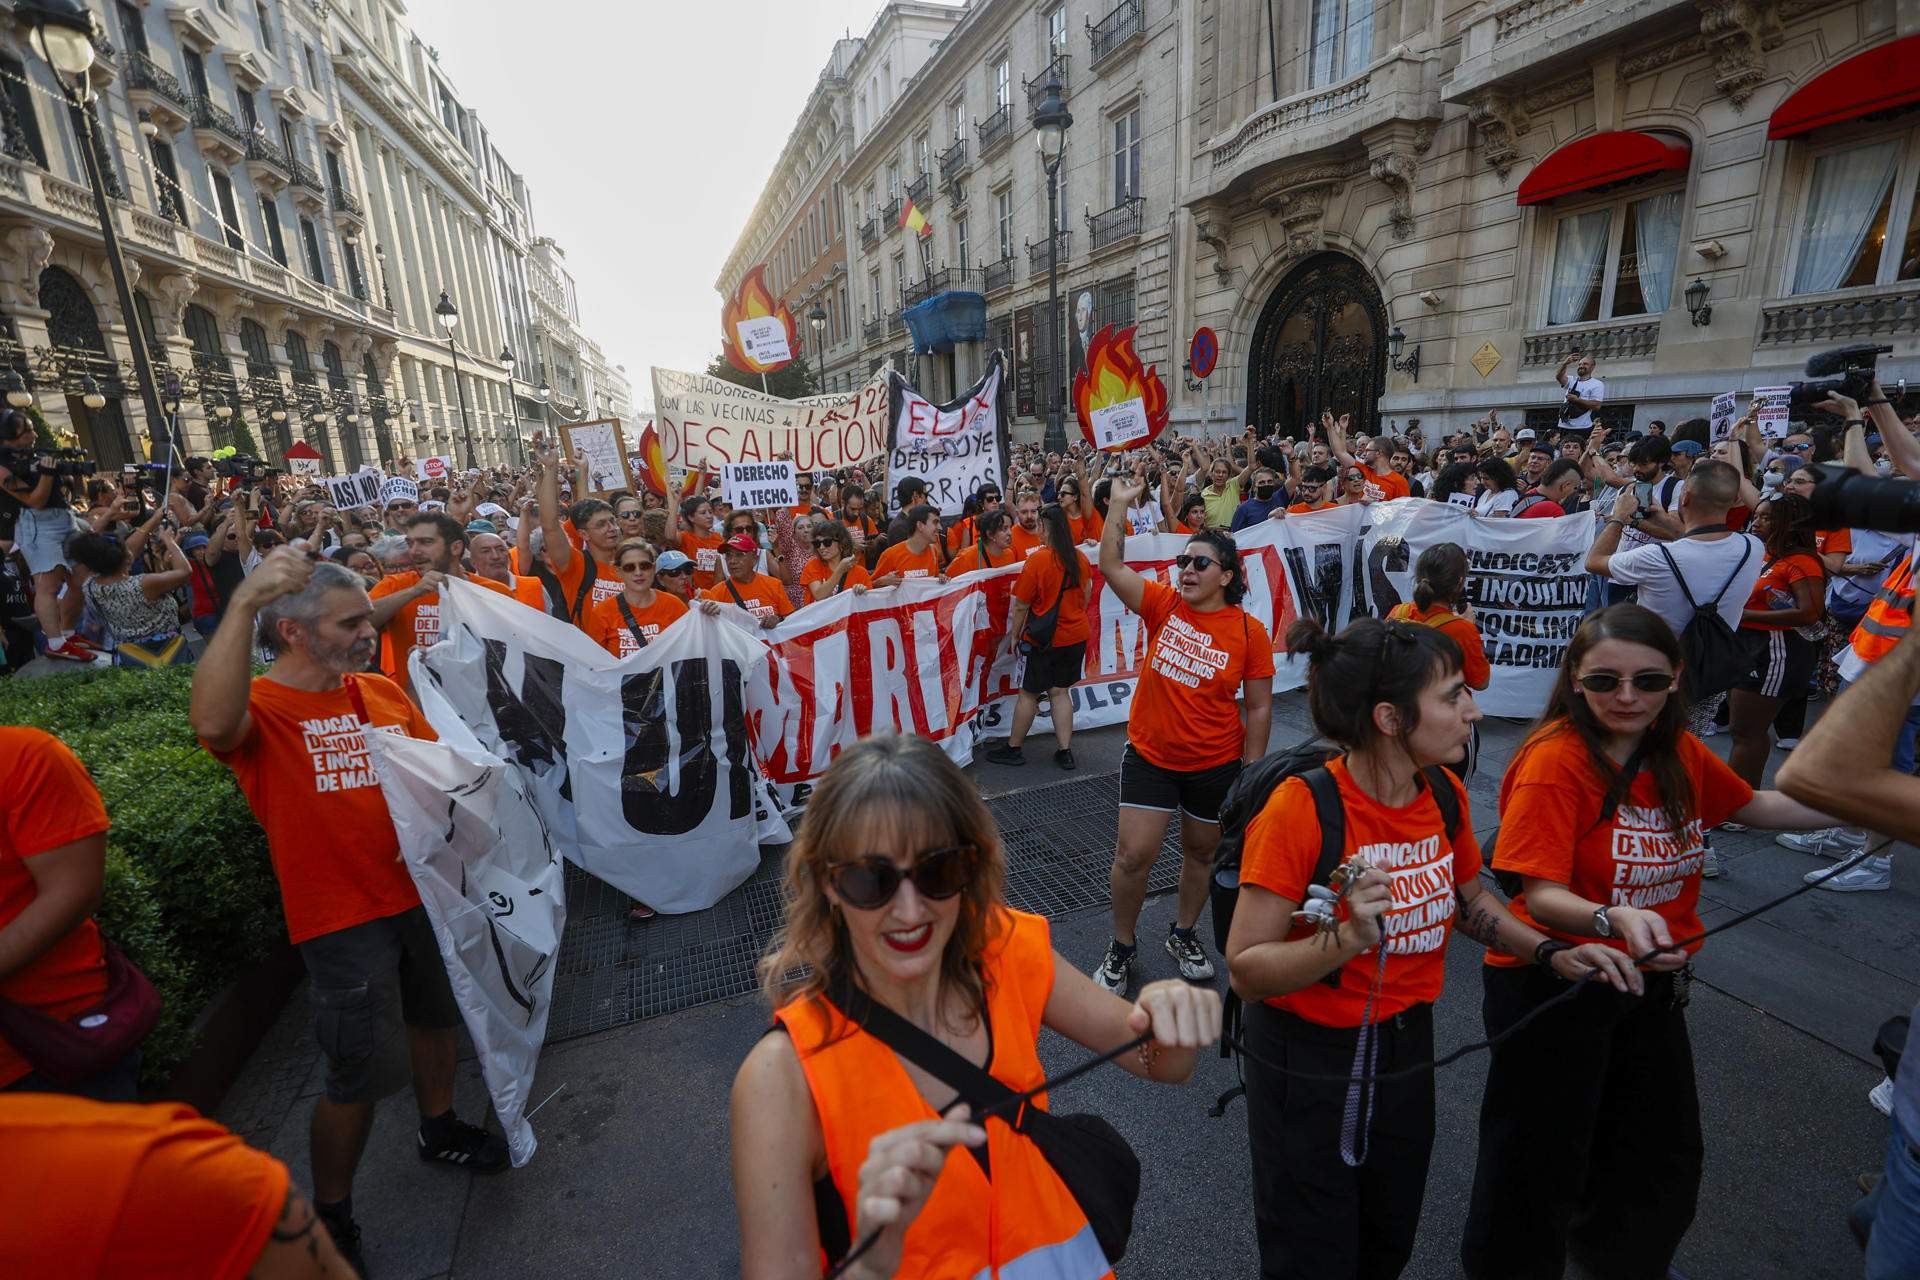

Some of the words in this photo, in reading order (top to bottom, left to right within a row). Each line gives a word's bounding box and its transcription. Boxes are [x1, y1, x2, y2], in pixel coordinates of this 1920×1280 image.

[660, 395, 679, 411] CON
[686, 399, 705, 416] LAS
[711, 402, 775, 425] VECINAS
[782, 416, 793, 427] de
[663, 416, 866, 472] DESAHUCIO
[425, 461, 443, 469] STOP
[734, 464, 789, 482] DERECHO
[360, 475, 378, 501] NO
[740, 490, 749, 506] A
[751, 488, 793, 505] TECHO.
[1480, 578, 1589, 609] INQUILIN
[1167, 614, 1213, 647] SINDICATO
[1161, 628, 1173, 643] DE
[1174, 635, 1227, 666] INQUILINAS
[1151, 656, 1161, 672] DE
[1160, 660, 1200, 689] MADRID
[1160, 646, 1216, 680] INQUILINOS
[316, 773, 340, 793] DE
[341, 769, 380, 790] MAD
[1613, 863, 1629, 885] E
[1631, 880, 1684, 909] MADRID
